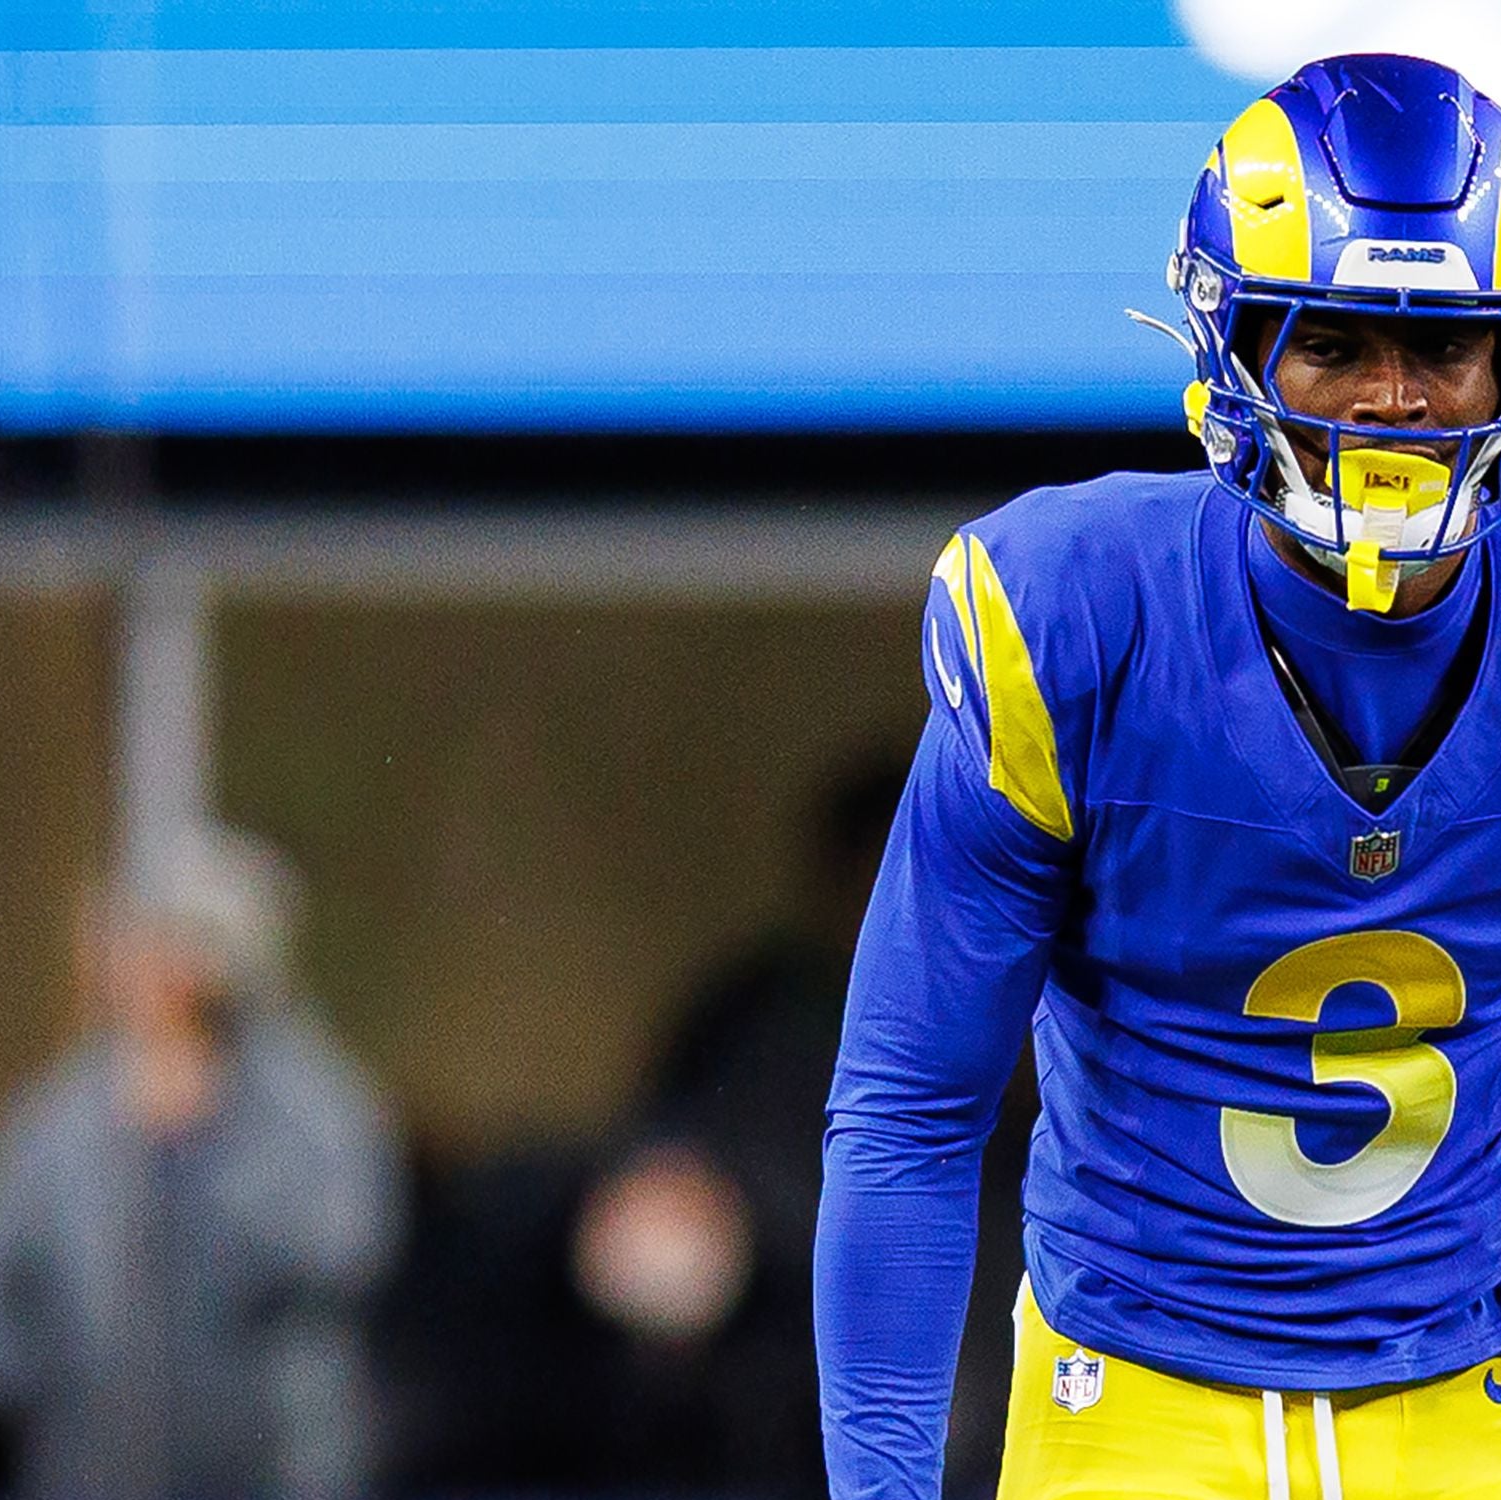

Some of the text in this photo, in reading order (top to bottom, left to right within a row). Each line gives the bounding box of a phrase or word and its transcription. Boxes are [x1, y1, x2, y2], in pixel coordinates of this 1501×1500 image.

[1367, 247, 1446, 264] RAMS
[1356, 851, 1393, 875] NFL
[1221, 929, 1466, 1228] 3
[1060, 1378, 1093, 1398] NFL
